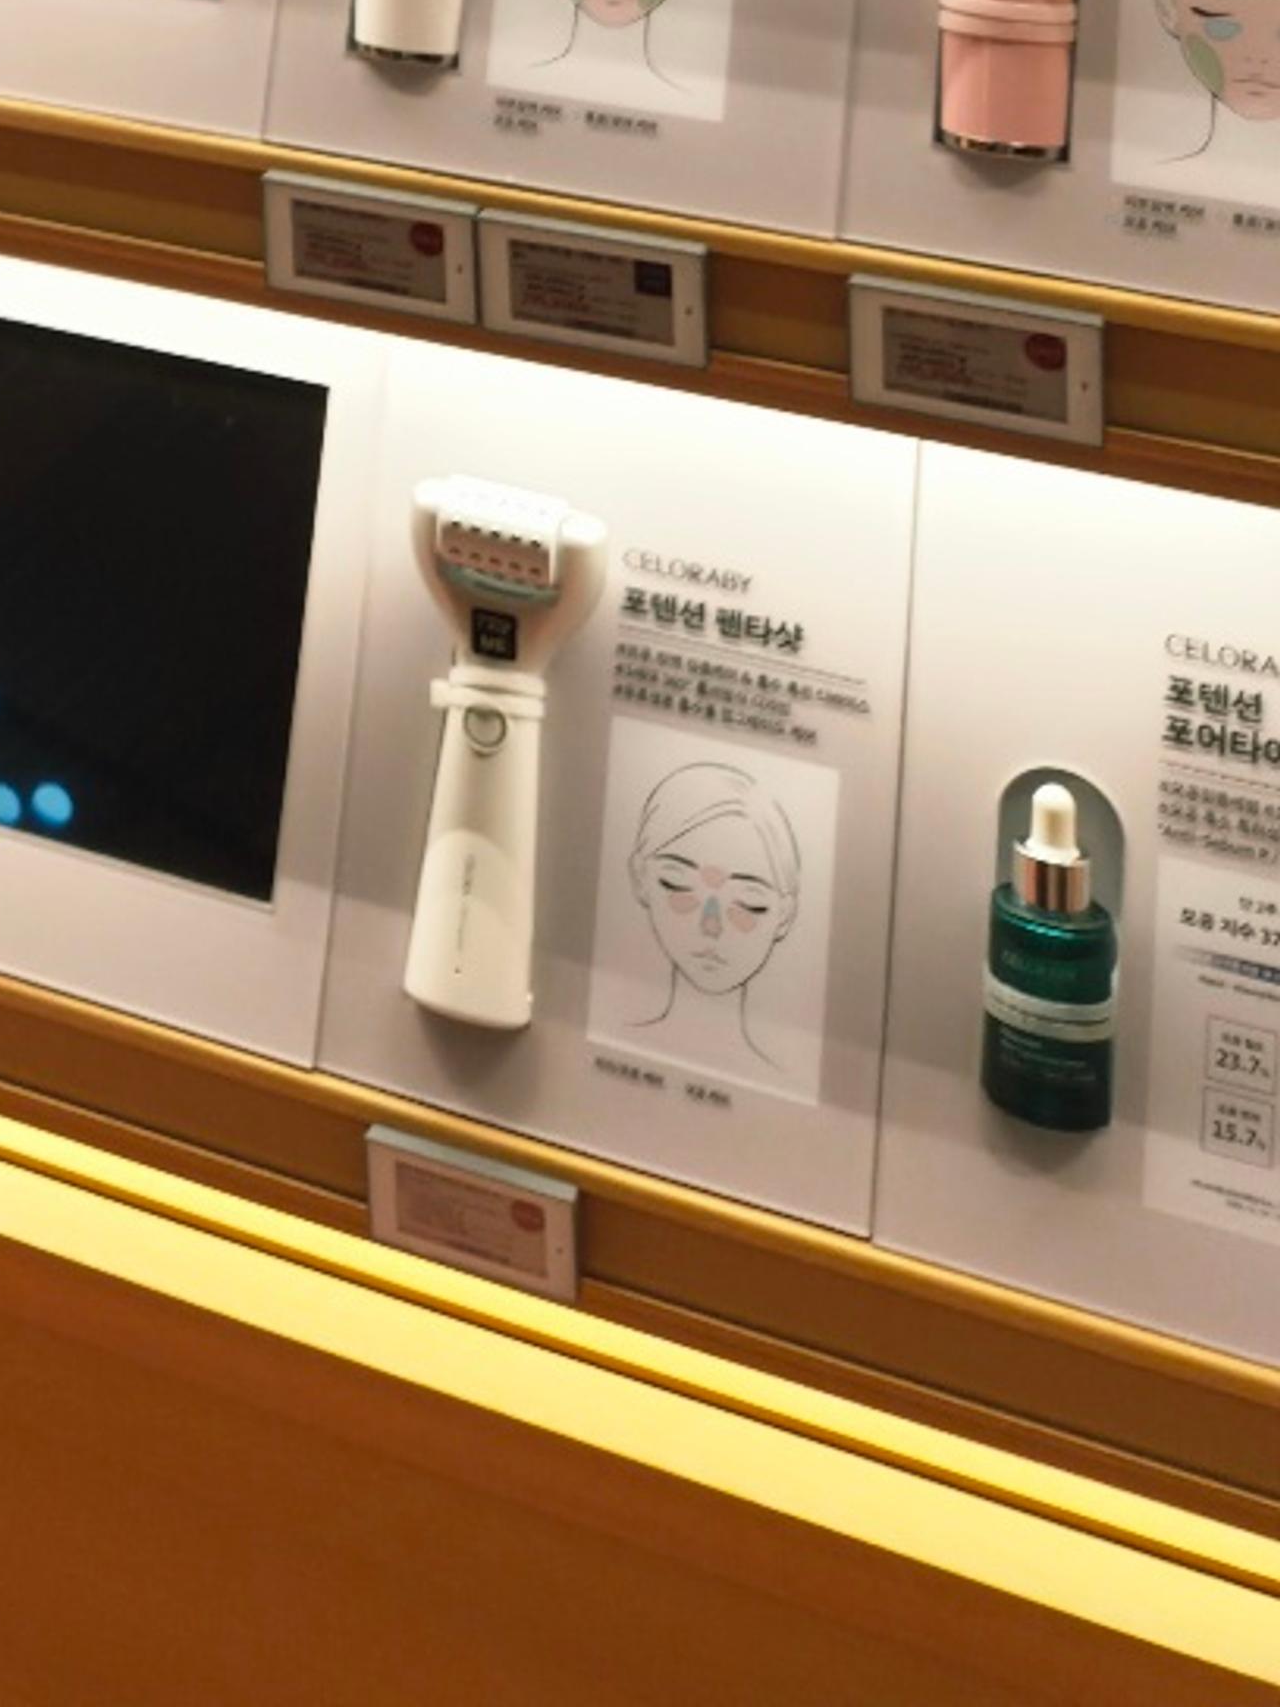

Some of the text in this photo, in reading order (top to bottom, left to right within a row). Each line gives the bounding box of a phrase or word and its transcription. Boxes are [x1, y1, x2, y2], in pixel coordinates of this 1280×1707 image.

[622, 548, 754, 594] CELORABY
[618, 586, 706, 631] 포텐션
[1164, 674, 1263, 725] 포텐션
